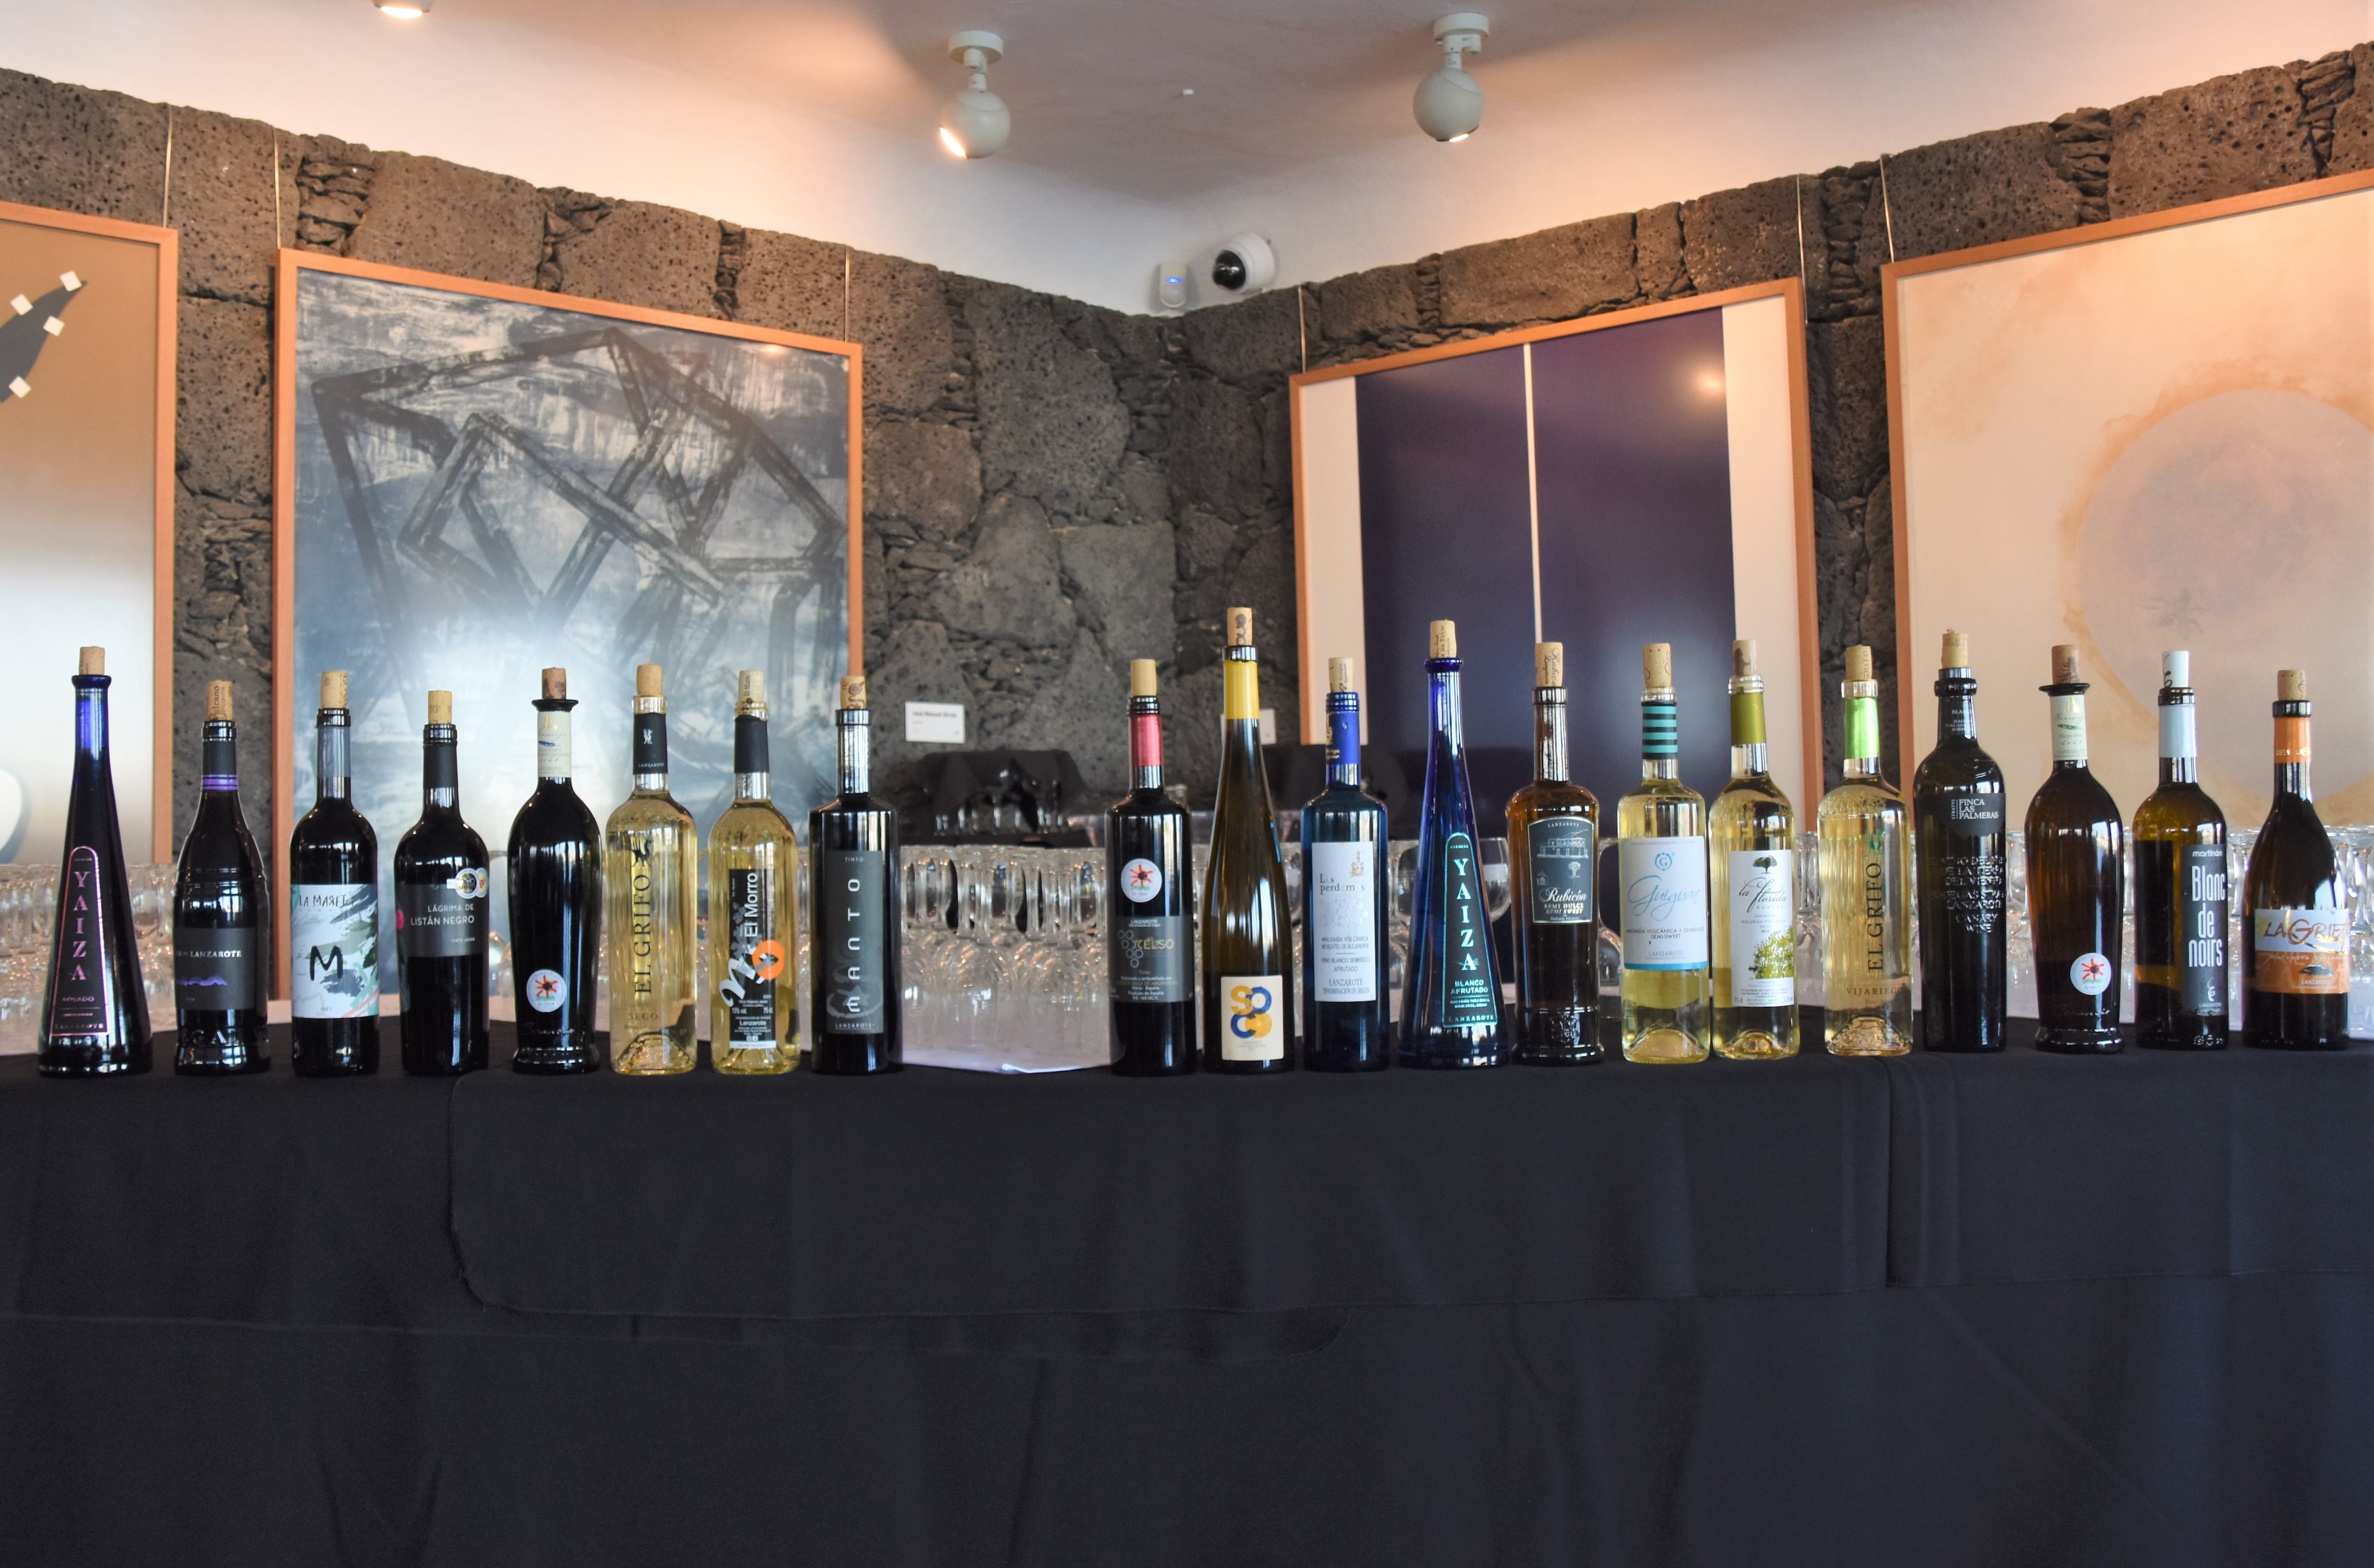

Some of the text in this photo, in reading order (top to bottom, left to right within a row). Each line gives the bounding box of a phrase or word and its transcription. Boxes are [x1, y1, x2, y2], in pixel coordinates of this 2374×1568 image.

[1959, 812, 1998, 820] PALMERAS
[1659, 857, 1667, 867] G
[1538, 887, 1588, 902] Rubicón
[2192, 865, 2225, 901] Blanc
[299, 896, 309, 907] LA
[427, 904, 462, 912] LÁGRIMA
[633, 874, 651, 957] GRIFO
[744, 873, 758, 937] El Morro
[1453, 858, 1477, 971] YAIZA
[71, 872, 91, 981] YAIZA
[410, 915, 475, 926] LISTÁN NEGRO
[1866, 863, 1884, 972] EL GRIFO
[2198, 902, 2214, 939] de
[190, 950, 242, 958] LANZAROTE
[310, 945, 344, 981] M
[2188, 939, 2223, 967] noirs
[634, 965, 651, 993] EL
[1454, 979, 1484, 987] BLANCO
[628, 1013, 659, 1021] SECO
